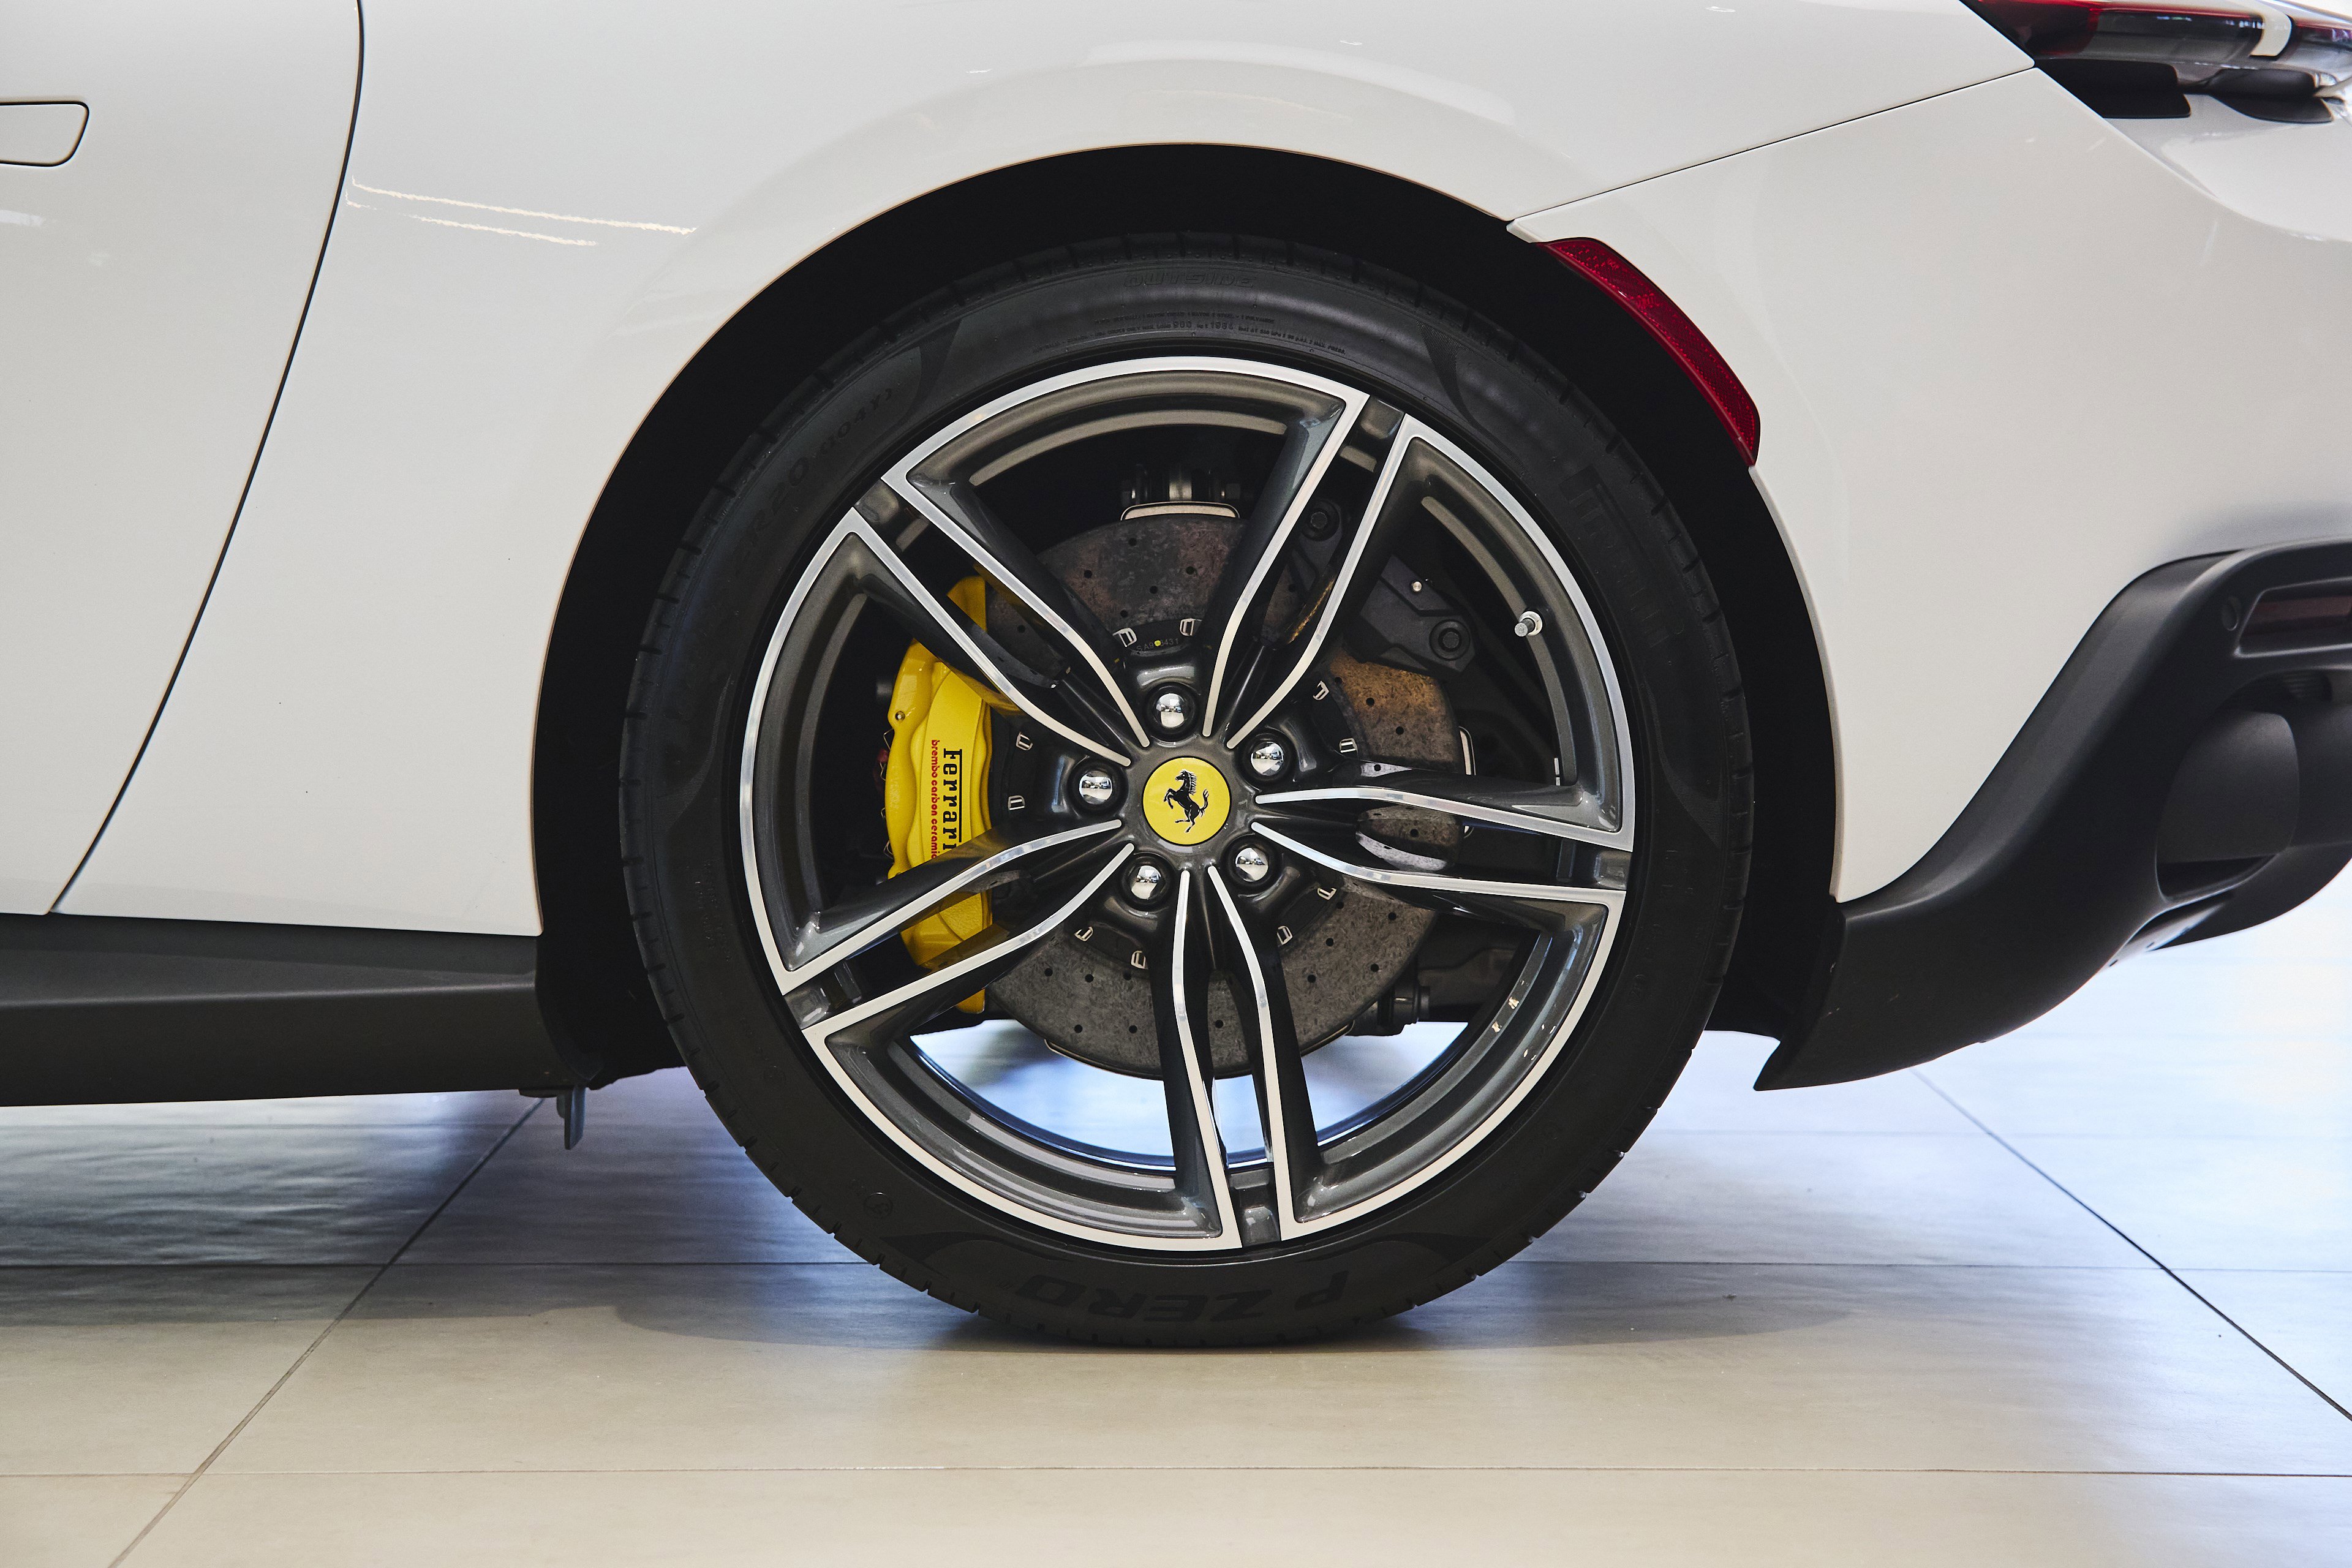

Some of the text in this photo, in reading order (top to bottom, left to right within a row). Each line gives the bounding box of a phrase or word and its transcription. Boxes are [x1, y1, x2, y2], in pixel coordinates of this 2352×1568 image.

[931, 739, 940, 778] brembo
[931, 780, 940, 816] carbon
[943, 748, 962, 850] Ferrari
[1014, 1270, 1349, 1323] P ZERO
